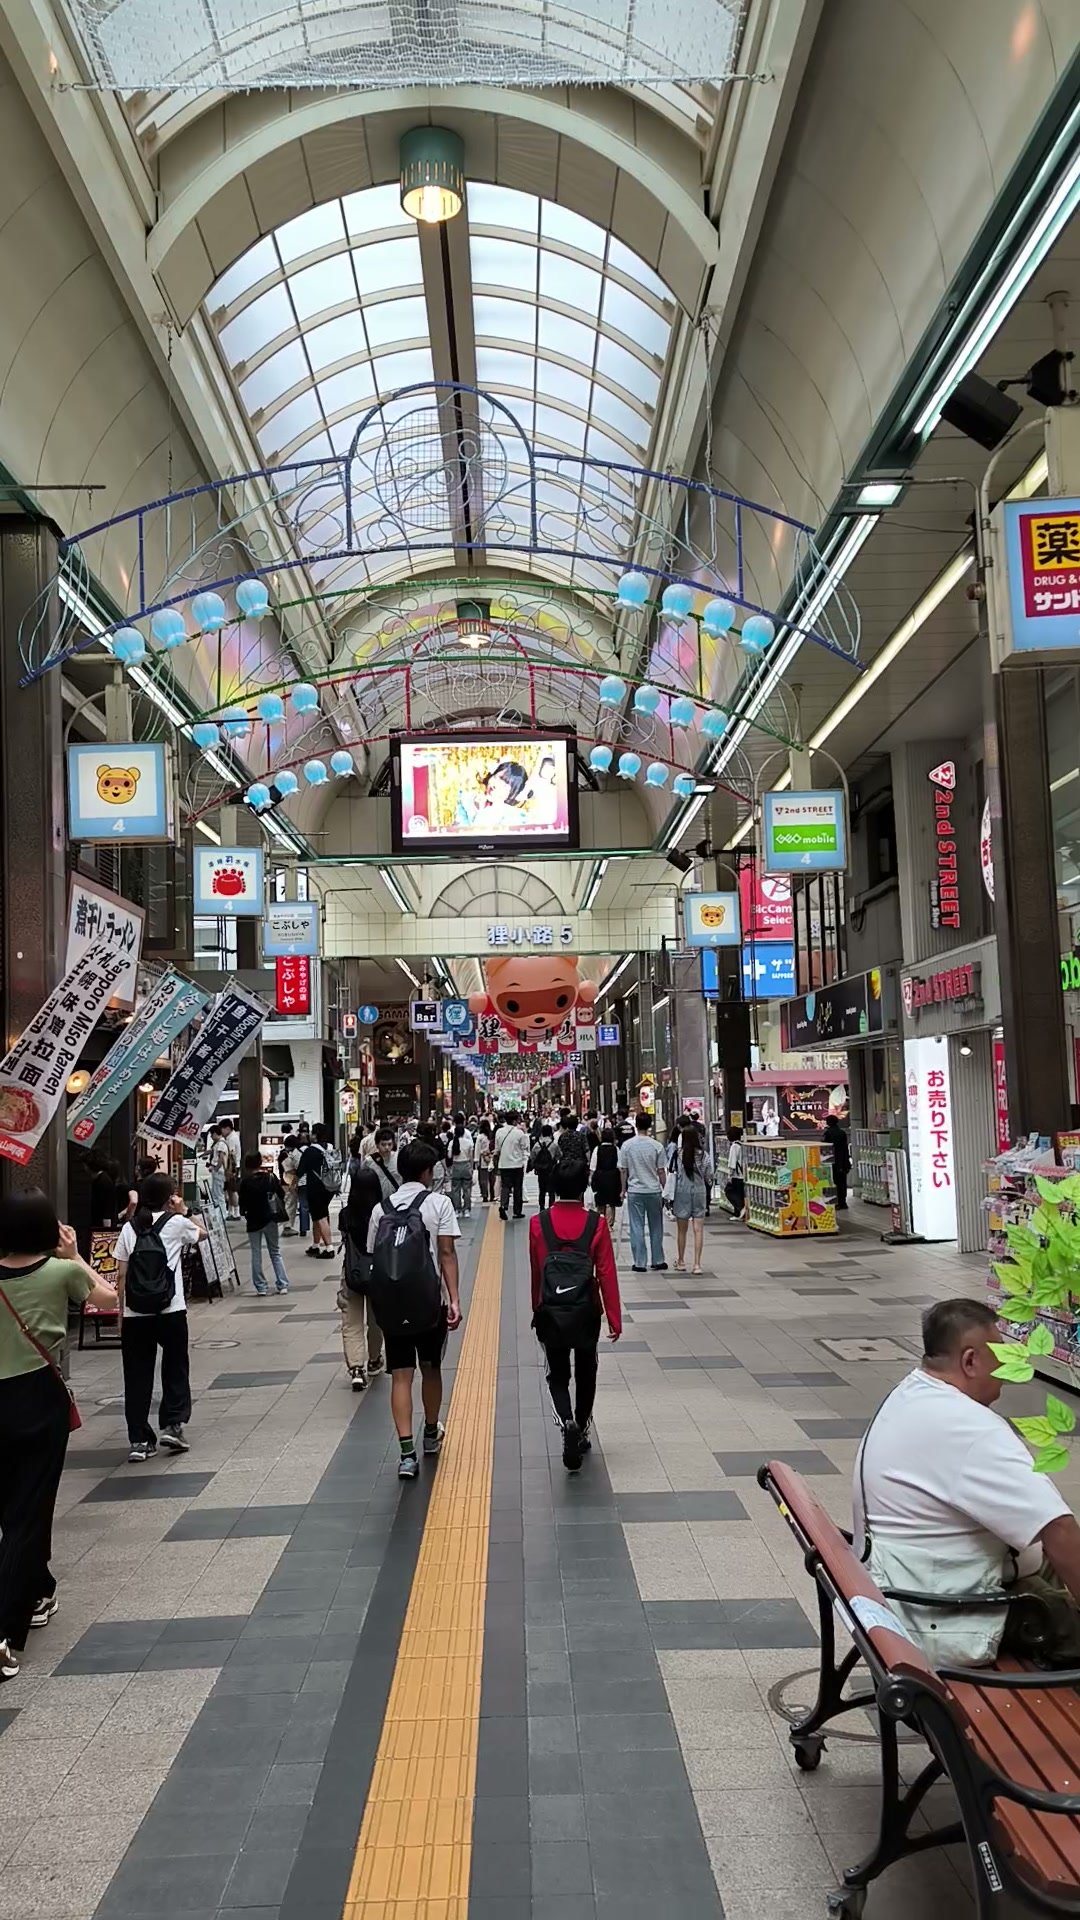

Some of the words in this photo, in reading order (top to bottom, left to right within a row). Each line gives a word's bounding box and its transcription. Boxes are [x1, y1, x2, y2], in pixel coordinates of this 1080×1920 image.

[1036, 521, 1080, 565] 薬
[1034, 576, 1067, 587] DRUG
[785, 806, 800, 814] 2nd
[802, 805, 833, 814] STREET
[934, 789, 957, 835] 2nd
[112, 819, 126, 833] 4
[802, 832, 835, 844] mobile
[801, 853, 811, 865] 4
[937, 840, 961, 928] STREET
[224, 901, 233, 911] 4
[272, 920, 310, 930] こぶしや
[560, 924, 573, 945] 5
[710, 934, 718, 943] 4
[84, 959, 131, 1011] Sapporo
[932, 963, 975, 1001] STREET
[229, 1010, 262, 1042] Niboshi
[416, 1013, 436, 1022] Bar
[65, 1011, 93, 1047] Miso
[42, 1047, 75, 1097] Ramen
[790, 1104, 823, 1112] CREMIA
[927, 1070, 951, 1188] お売り下さい
